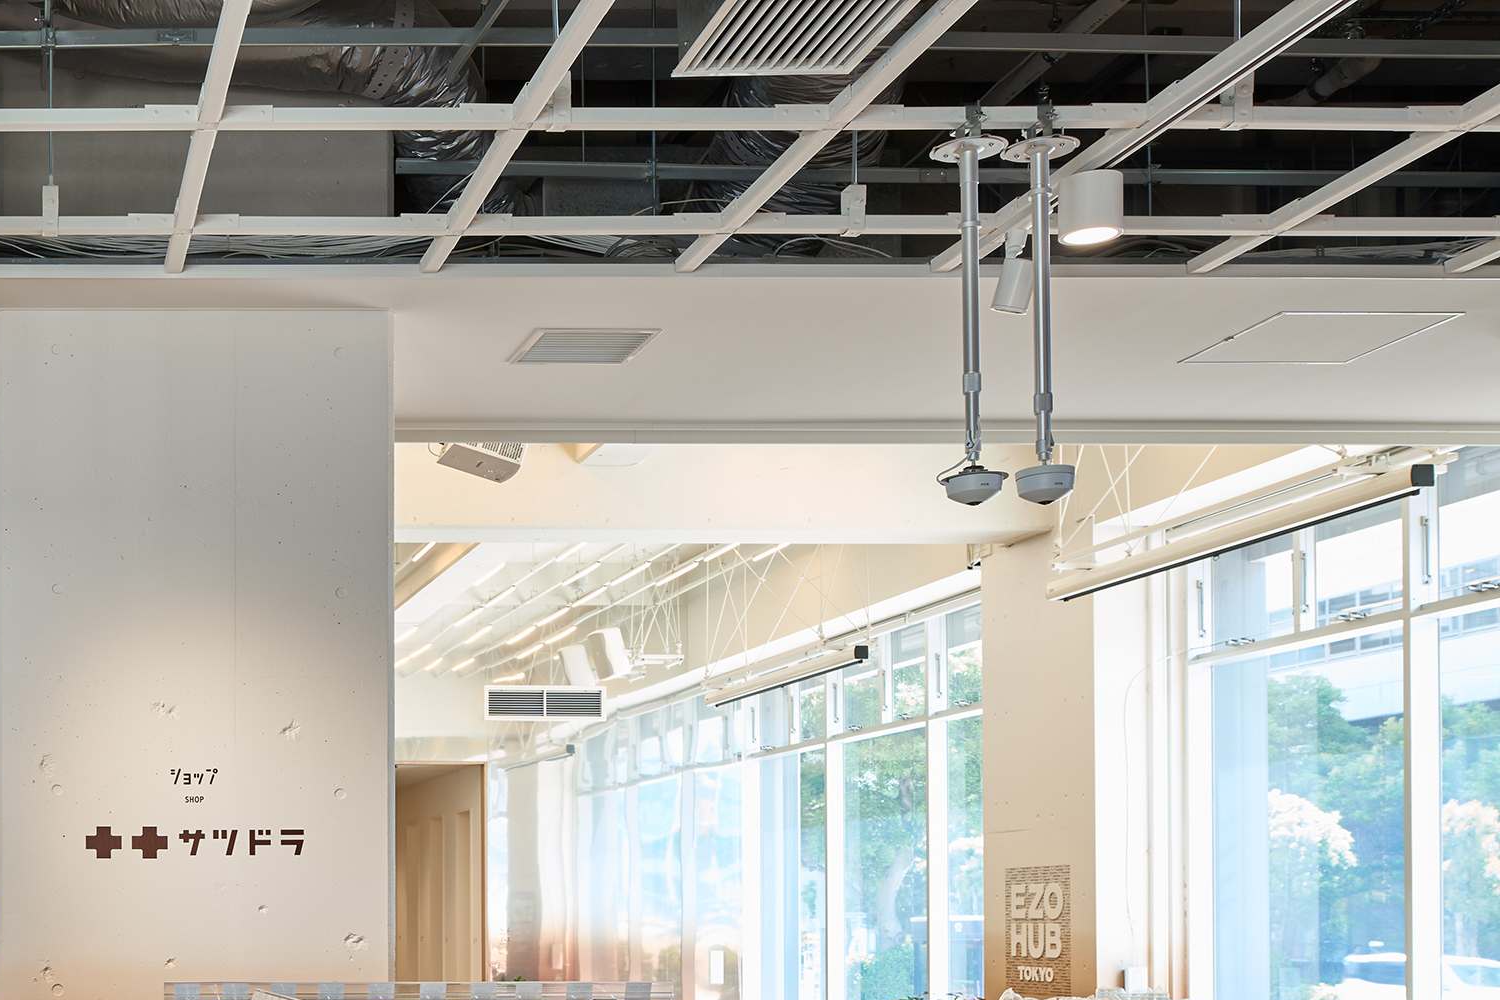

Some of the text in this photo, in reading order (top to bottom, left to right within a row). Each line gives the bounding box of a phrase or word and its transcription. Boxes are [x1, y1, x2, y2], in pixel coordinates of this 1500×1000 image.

[170, 767, 219, 786] ショップ
[184, 795, 206, 804] SHOP
[178, 828, 305, 857] サツドラ
[1010, 882, 1064, 920] EZO
[1010, 922, 1062, 959] HUB
[1017, 965, 1054, 983] TOKYO
